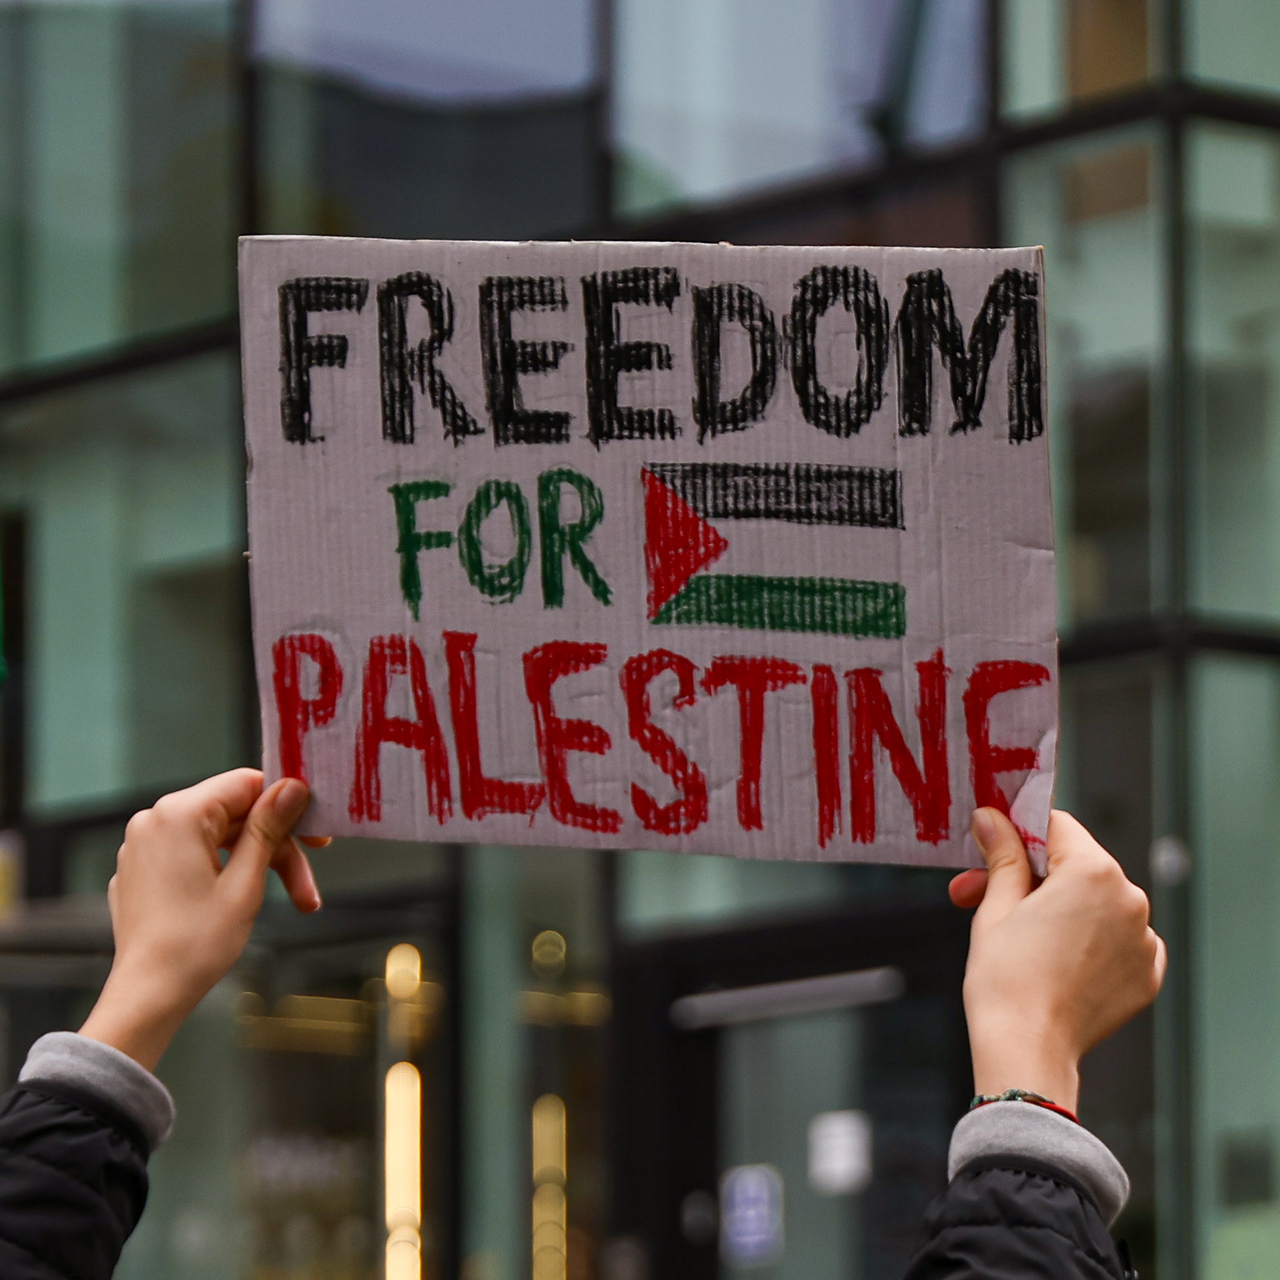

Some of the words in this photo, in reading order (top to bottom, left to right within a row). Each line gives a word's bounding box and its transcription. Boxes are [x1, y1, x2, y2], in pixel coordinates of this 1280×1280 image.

[276, 266, 1043, 446] FREEDOM
[387, 467, 612, 619] FOR
[272, 631, 1050, 848] PALESTINE
